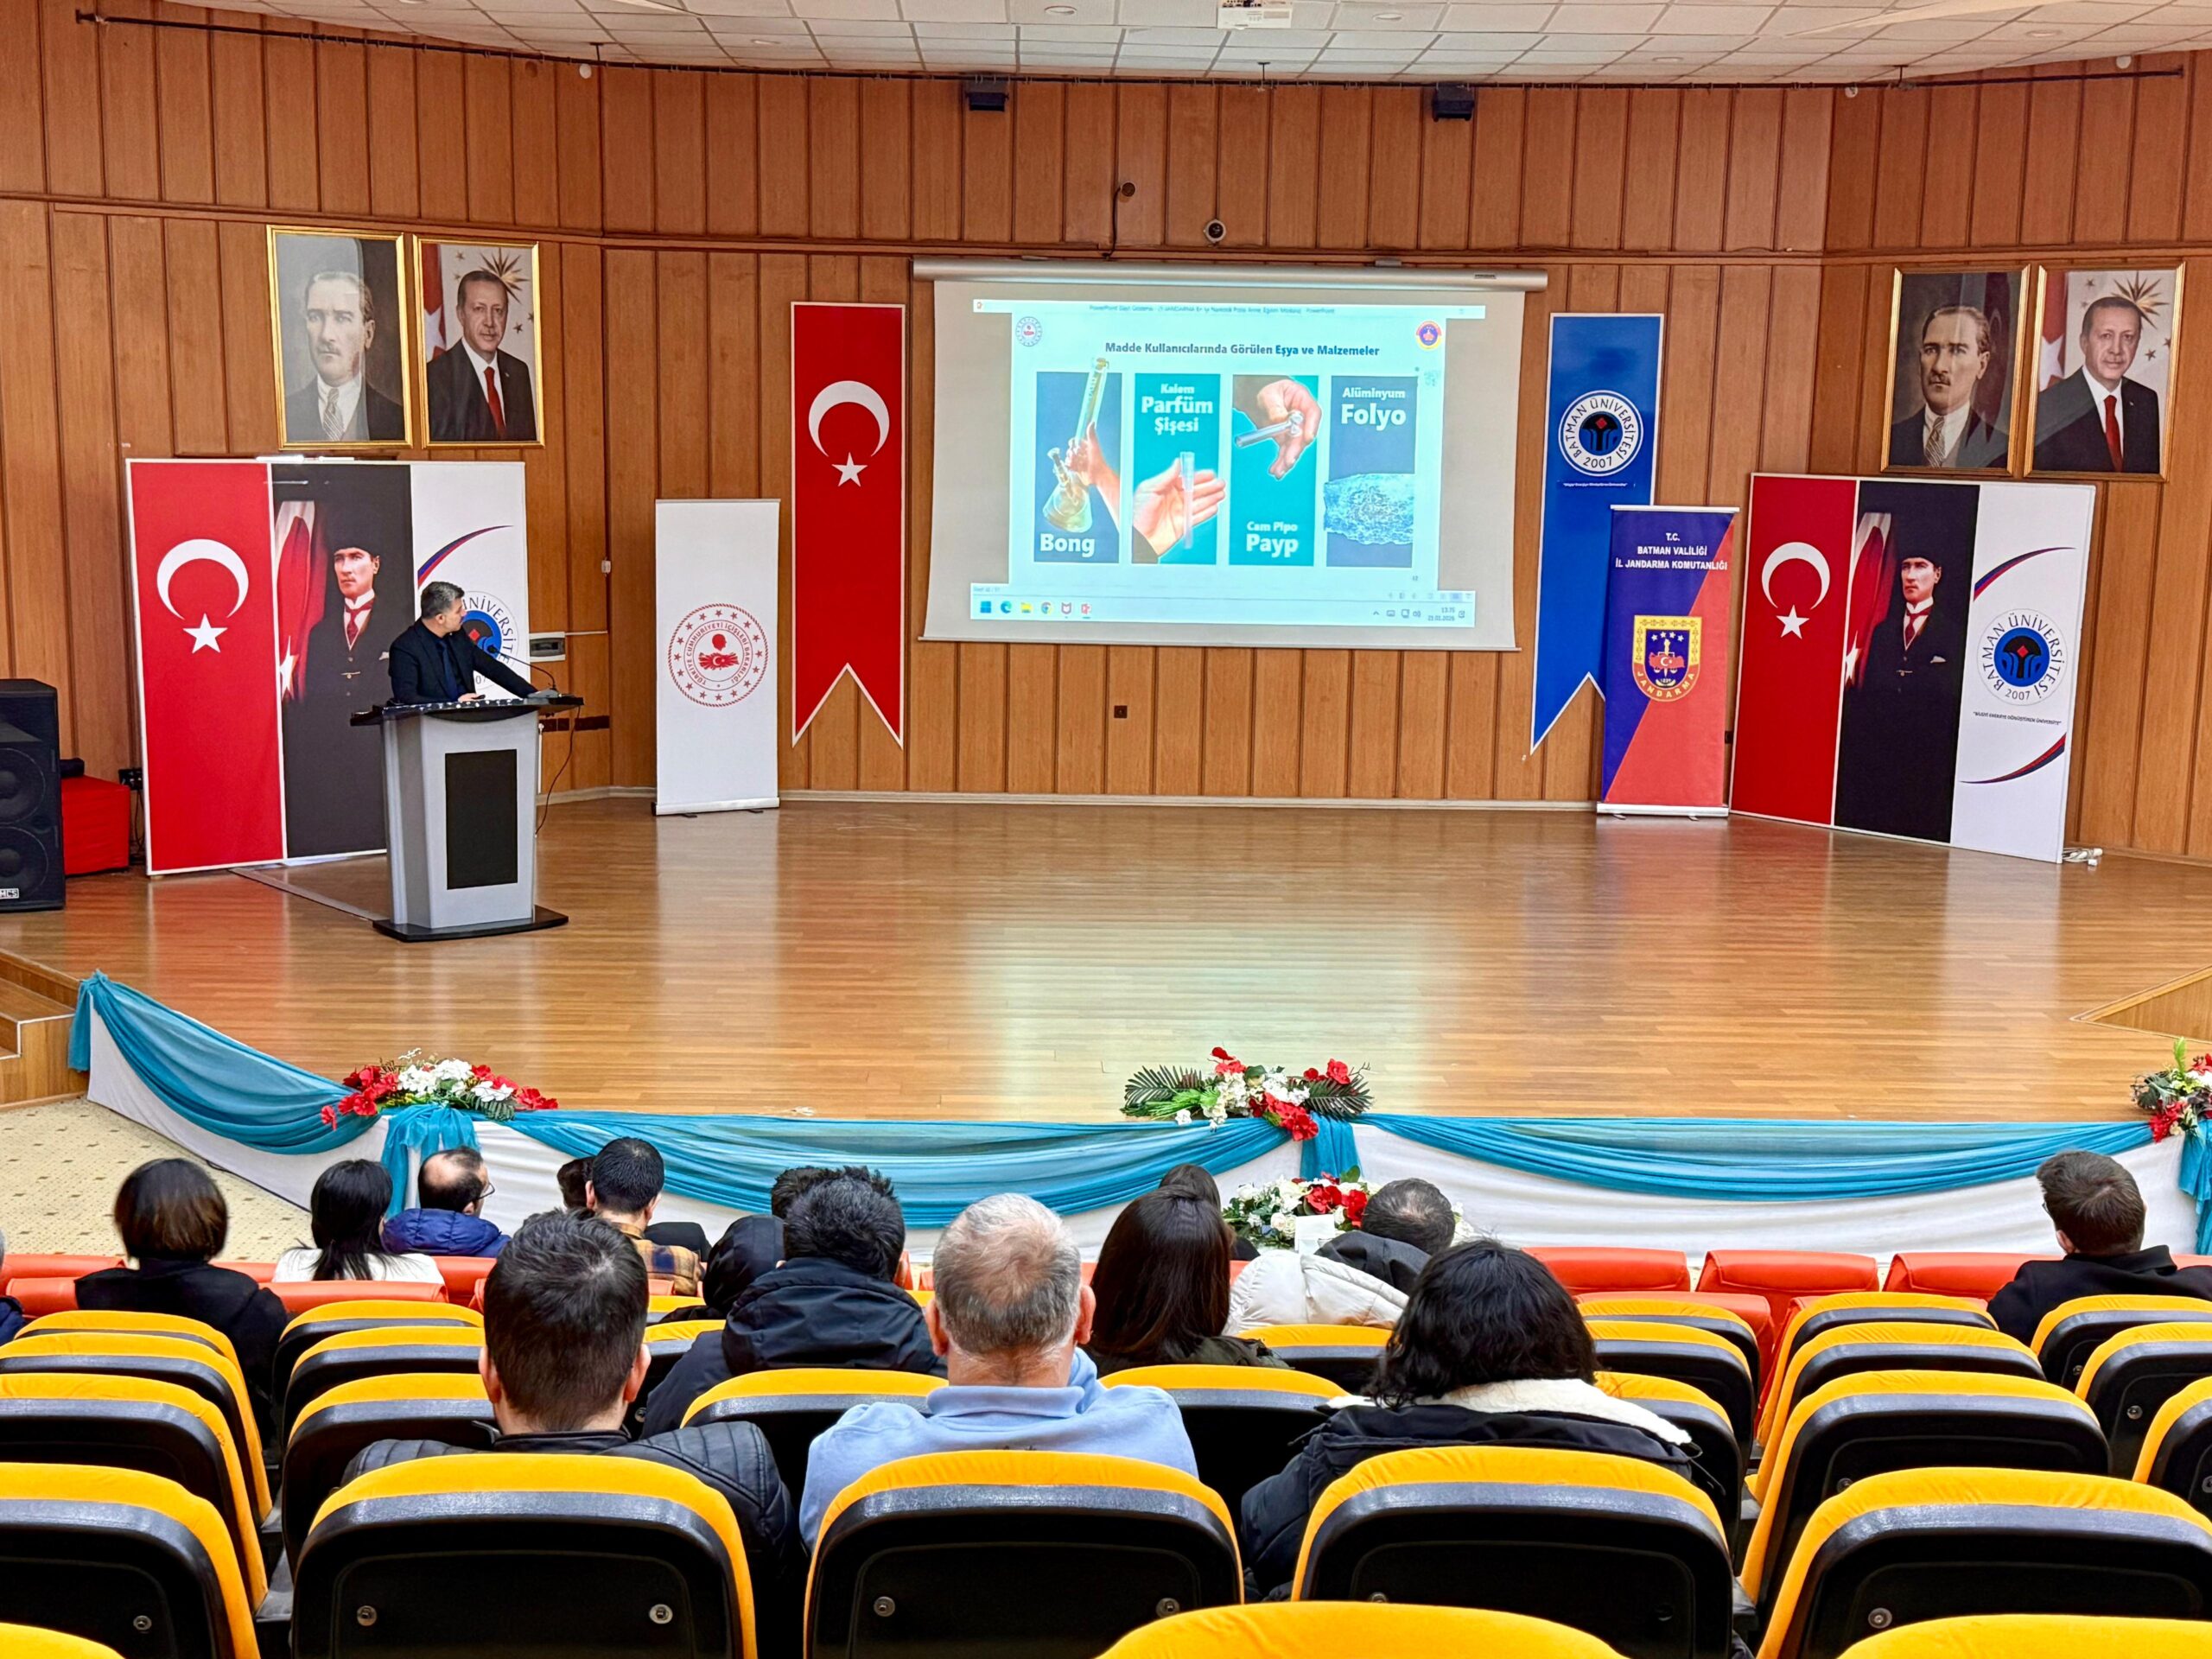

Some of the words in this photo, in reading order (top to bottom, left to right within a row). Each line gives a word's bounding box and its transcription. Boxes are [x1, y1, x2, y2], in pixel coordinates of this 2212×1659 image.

[1105, 342, 1141, 353] Madde
[1145, 343, 1228, 354] Kullanıcılarında
[1230, 343, 1273, 355] Görülen
[1275, 345, 1299, 357] Eşya
[1301, 346, 1314, 355] ve
[1317, 346, 1380, 356] Malzemeler
[1160, 384, 1195, 394] Kalem
[1342, 387, 1406, 400] Alüminyum
[1141, 396, 1214, 415] Parfüm
[1341, 403, 1407, 431] Folyo
[1154, 416, 1199, 435] Şişesi
[1566, 404, 1587, 458] BATMAN
[1583, 456, 1613, 468] 2007
[1247, 521, 1270, 532] Cam
[1273, 521, 1298, 533] Pipo
[1665, 532, 1681, 542] T.C.
[1039, 533, 1096, 558] Bong
[1246, 534, 1300, 558] Payp
[1637, 545, 1671, 556] BATMAN
[1673, 545, 1707, 556] VALİLİĞİ
[1615, 557, 1624, 568] İL
[1625, 560, 1669, 569] JANDARMA
[1672, 560, 1728, 570] KOMUTANLIĞI
[1982, 623, 2005, 690] BATMAN
[2008, 613, 2064, 698] ÜNİVERSİTESİ
[1637, 671, 1695, 698] JANDARMA
[2005, 689, 2031, 701] 2007
